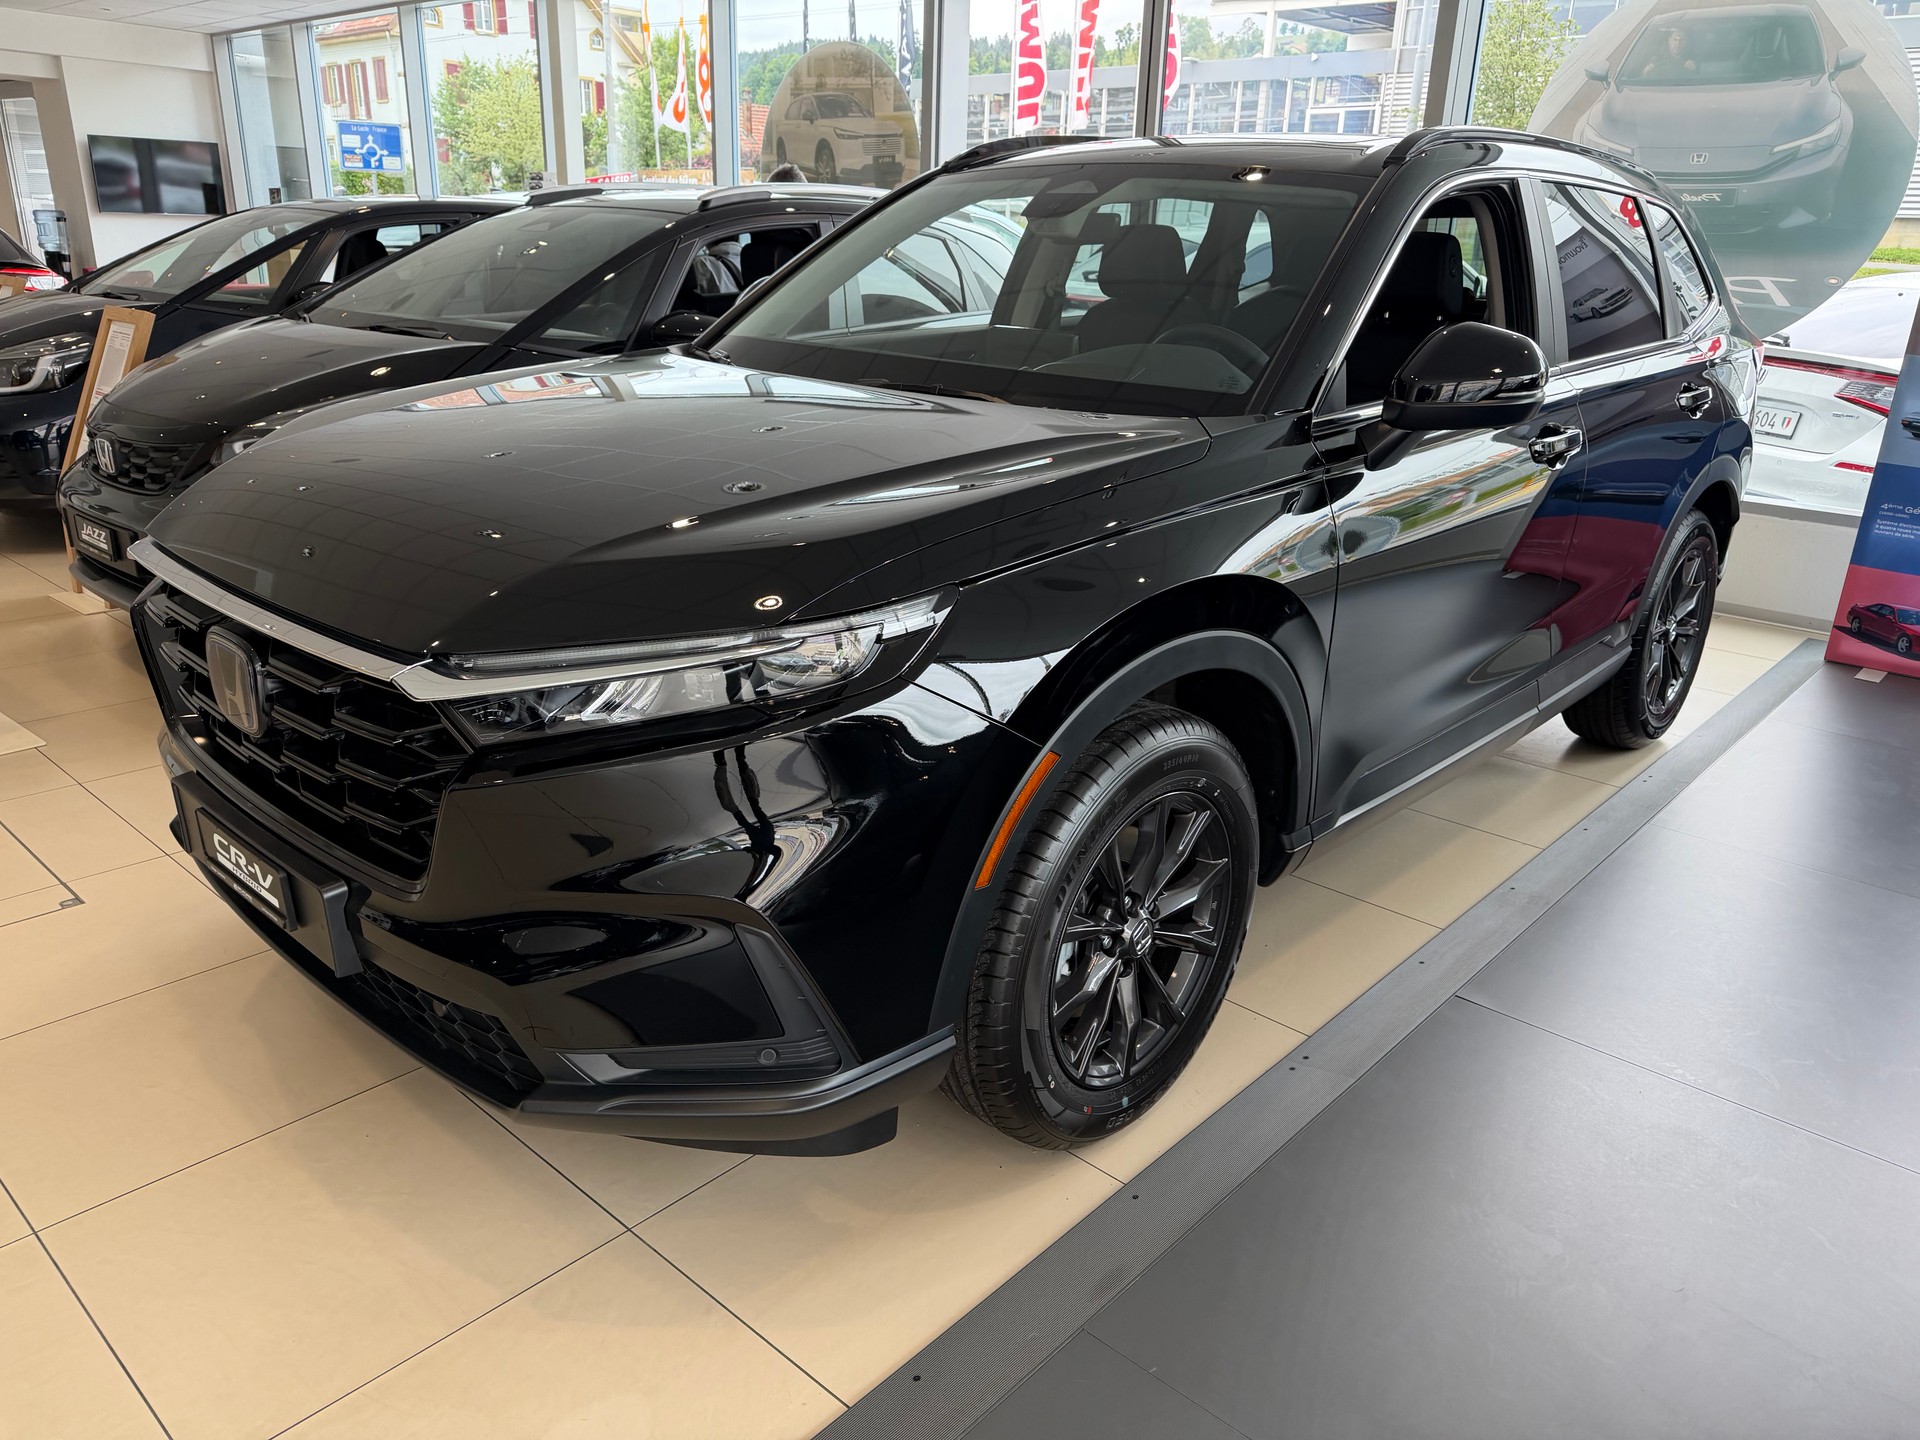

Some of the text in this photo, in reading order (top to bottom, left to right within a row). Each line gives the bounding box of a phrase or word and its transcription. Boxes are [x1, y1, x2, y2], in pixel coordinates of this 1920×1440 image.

[81, 523, 107, 542] JAZZ
[213, 833, 273, 889] CR-V
[232, 866, 262, 893] HYBRID
